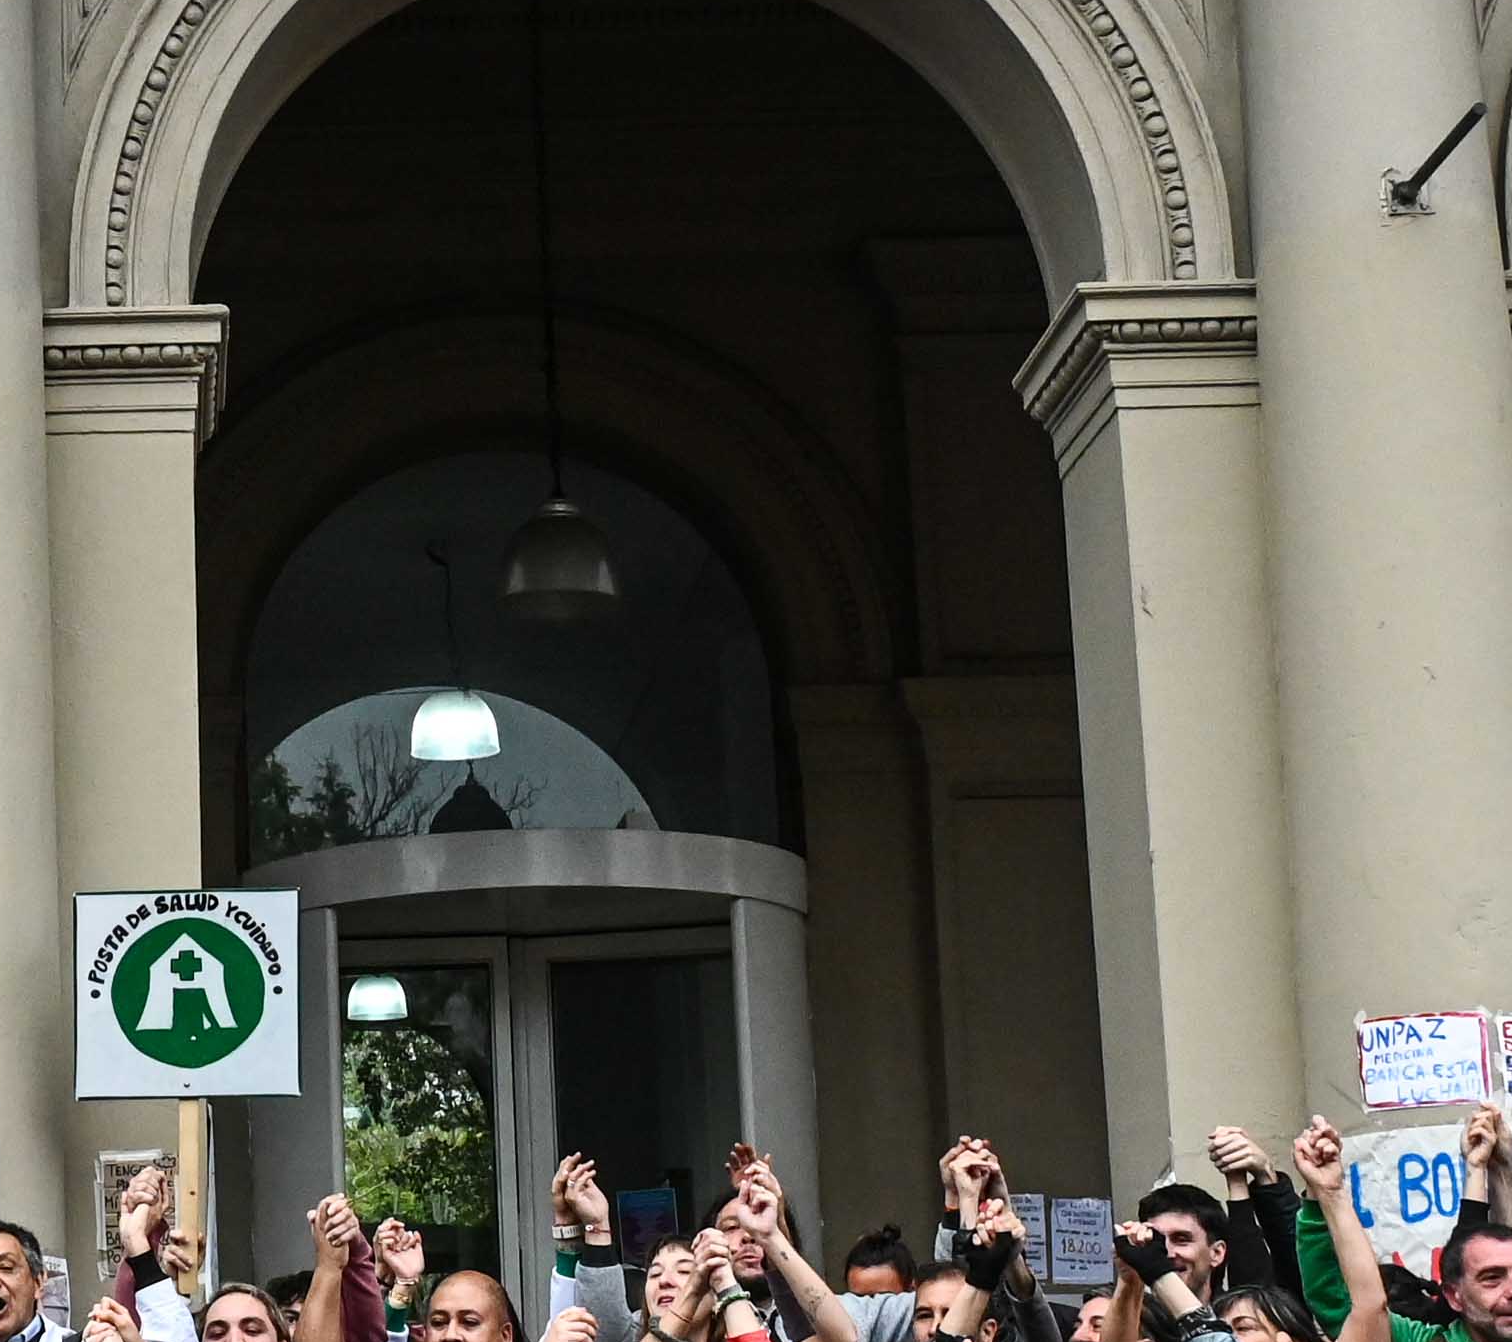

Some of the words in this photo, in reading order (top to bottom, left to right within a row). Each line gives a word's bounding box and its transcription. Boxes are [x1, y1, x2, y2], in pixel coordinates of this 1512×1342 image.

[88, 922, 129, 985] POSTA
[126, 902, 152, 930] DE
[155, 893, 219, 915] SALUD
[224, 901, 238, 918] Y
[1362, 1018, 1446, 1052] UNPAZ
[1366, 1063, 1426, 1086] BANCA
[1433, 1060, 1477, 1080] ESTA
